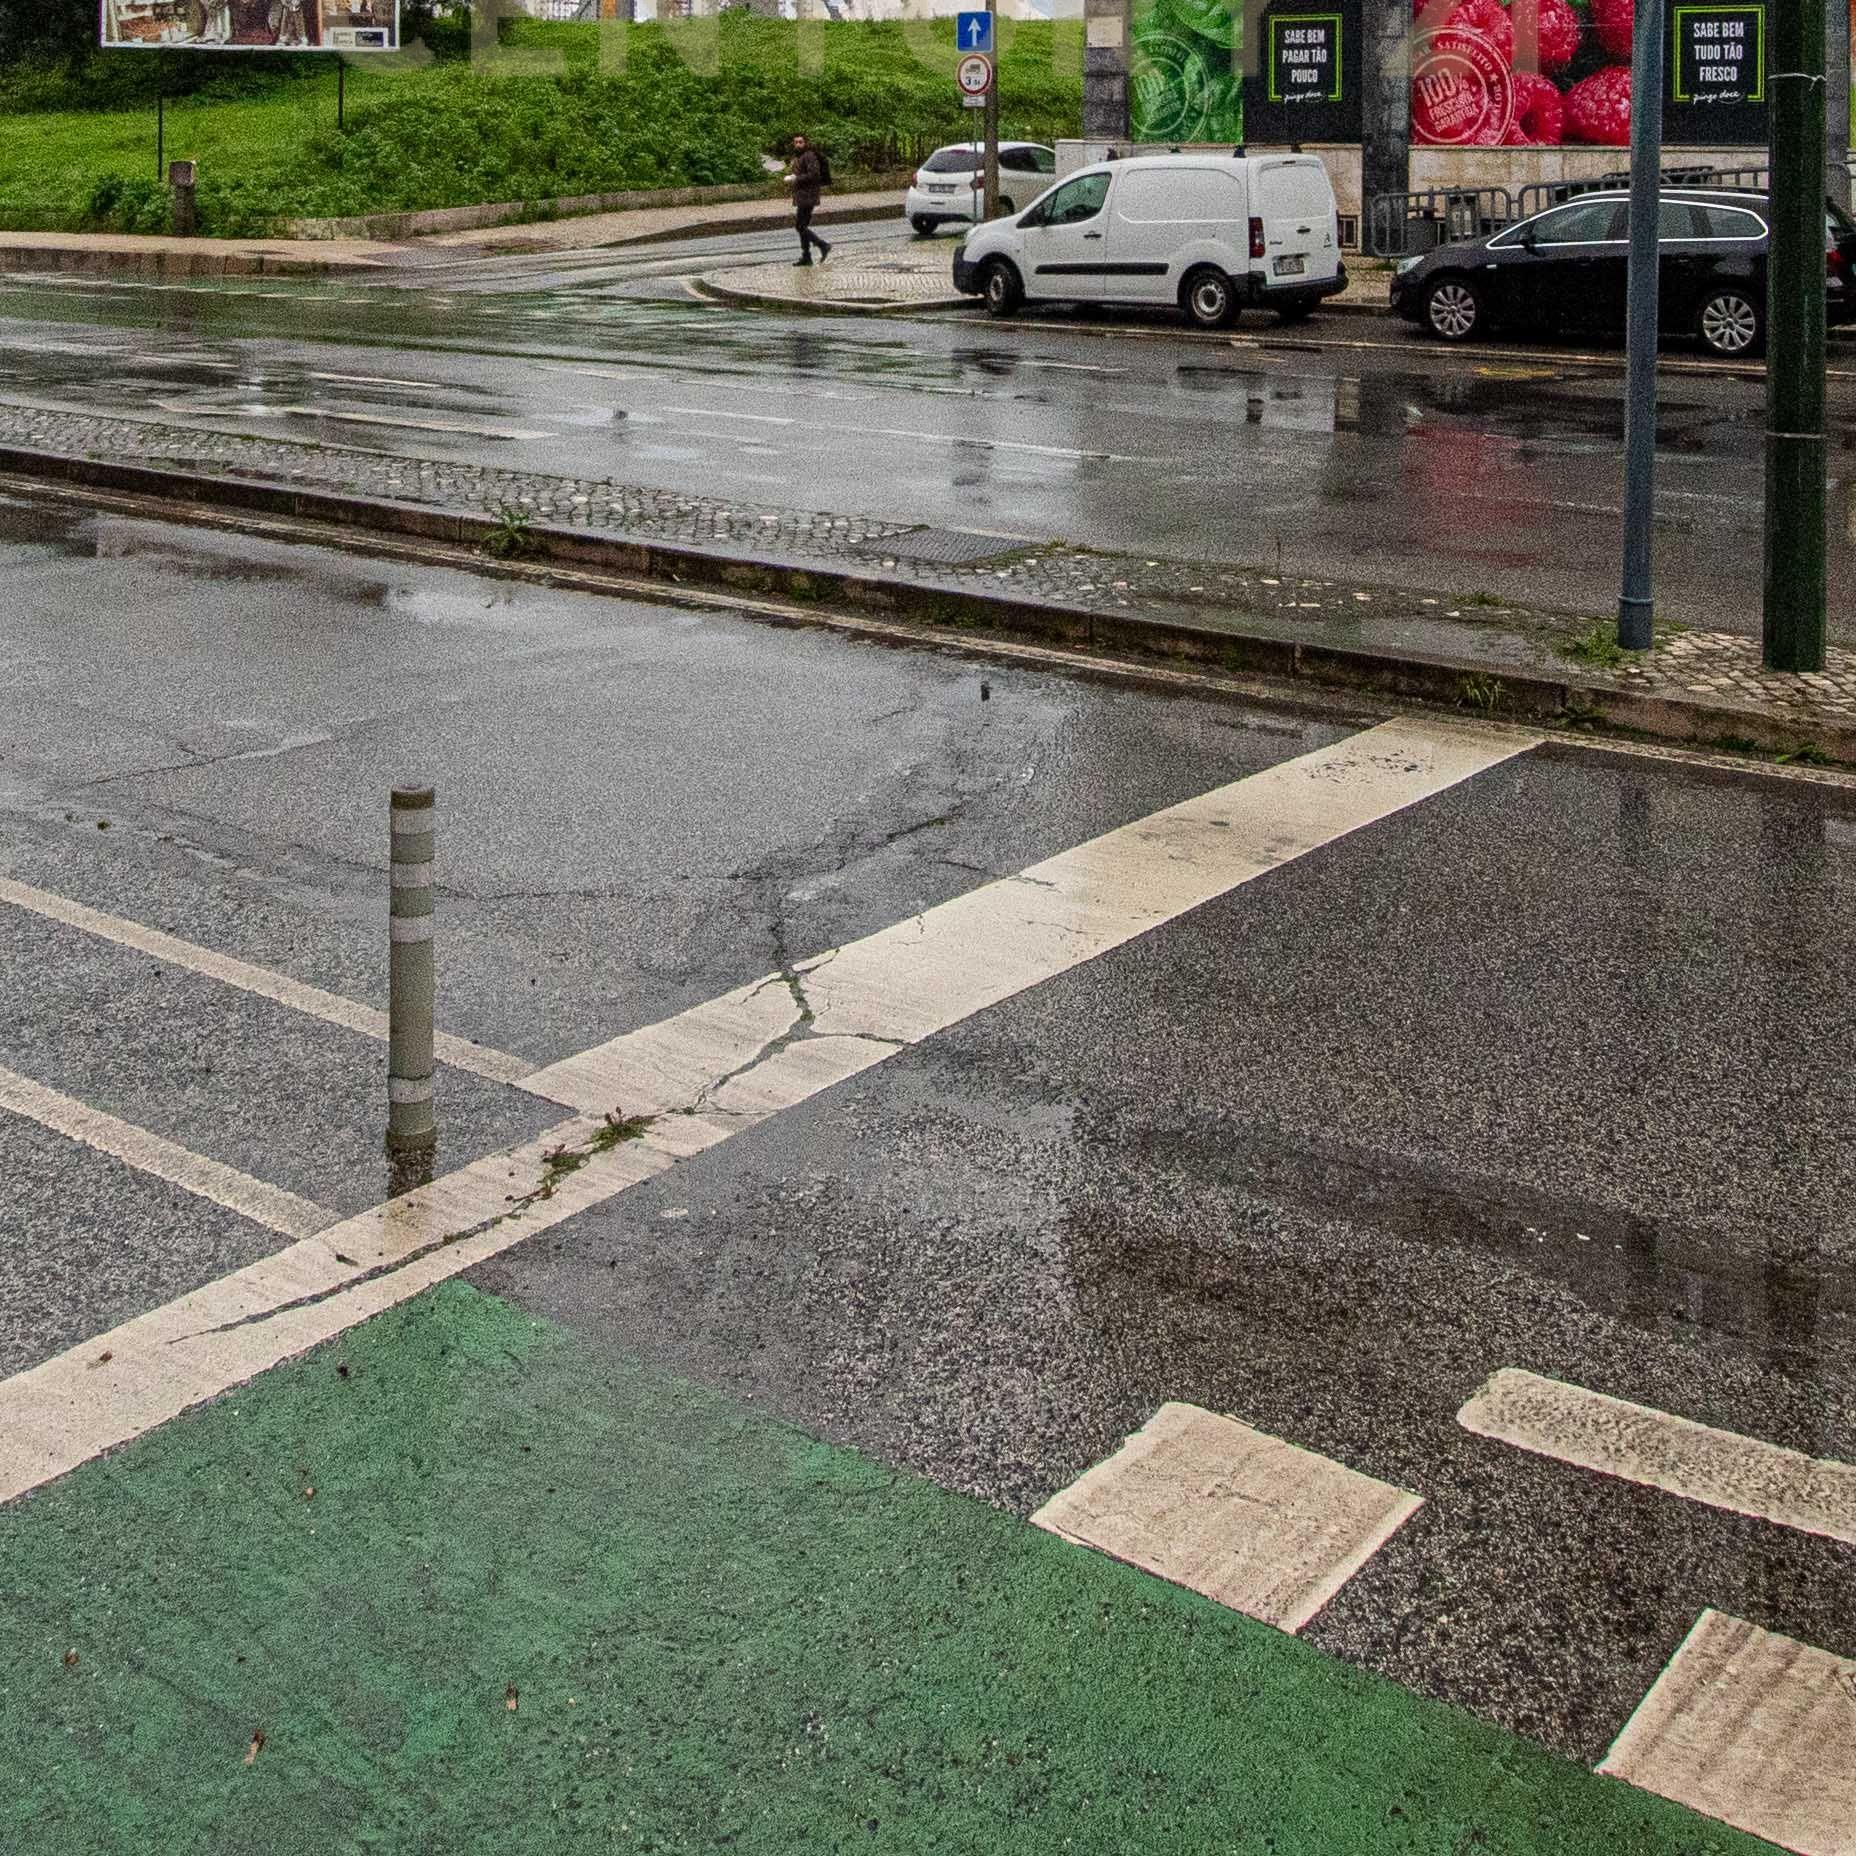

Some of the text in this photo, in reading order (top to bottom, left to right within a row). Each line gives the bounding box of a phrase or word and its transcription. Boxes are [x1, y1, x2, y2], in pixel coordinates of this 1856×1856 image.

[1285, 29, 1325, 43] SABE BEM
[1693, 21, 1744, 37] SABE BEM
[1282, 49, 1310, 63] PAGAR
[1694, 42, 1744, 60] TUDO TÃO
[1291, 69, 1318, 83] POUCO
[1699, 66, 1737, 82] FRESCO
